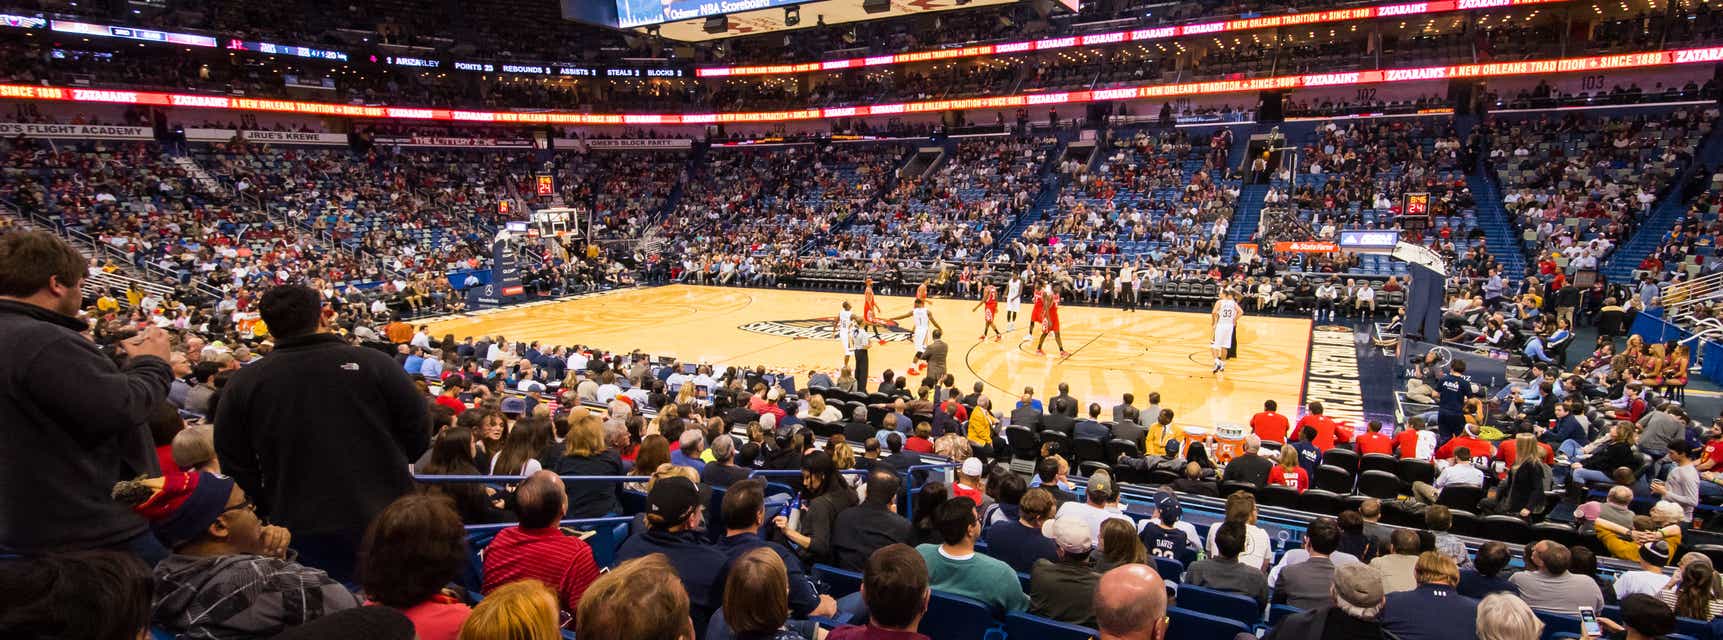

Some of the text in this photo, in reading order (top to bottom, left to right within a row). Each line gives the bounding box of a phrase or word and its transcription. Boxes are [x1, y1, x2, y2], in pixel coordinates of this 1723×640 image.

[700, 3, 720, 15] NBA
[721, 0, 770, 13] Scoreboard
[1233, 20, 1248, 29] NEW
[1249, 16, 1281, 28] ORLEANS
[1282, 13, 1320, 25] TRADITION
[1328, 10, 1351, 20] SINCE
[455, 62, 482, 72] POINTS
[502, 64, 543, 74] REBOUNDS
[560, 67, 589, 76] ASSISTS
[607, 69, 633, 77] STEALS
[647, 69, 674, 77] BLOCKS
[1449, 66, 1456, 77] A
[1458, 64, 1481, 76] NEW
[1482, 61, 1528, 75] ORLEANS
[1530, 58, 1586, 73] TRADITION
[1600, 55, 1633, 68] SINCE
[1637, 52, 1663, 66] 1889
[1139, 87, 1146, 97] A
[1146, 86, 1163, 97] NEW
[1164, 83, 1198, 96] ORLEANS
[1200, 80, 1241, 94] TRADITION
[1250, 78, 1274, 90] SINCE
[1581, 75, 1606, 90] 103
[0, 84, 34, 98] SINCE
[1357, 87, 1377, 101] 102
[231, 97, 239, 109] A
[25, 124, 77, 135] FLIGHT
[82, 126, 143, 136] ACADEMY
[247, 131, 321, 142] JRUE'S KREWE
[414, 136, 432, 145] THE
[433, 137, 472, 146] LOTTERY
[539, 184, 551, 193] 24
[1408, 203, 1424, 214] 24
[1222, 309, 1233, 319] 33
[1156, 538, 1175, 550] DAVIS
